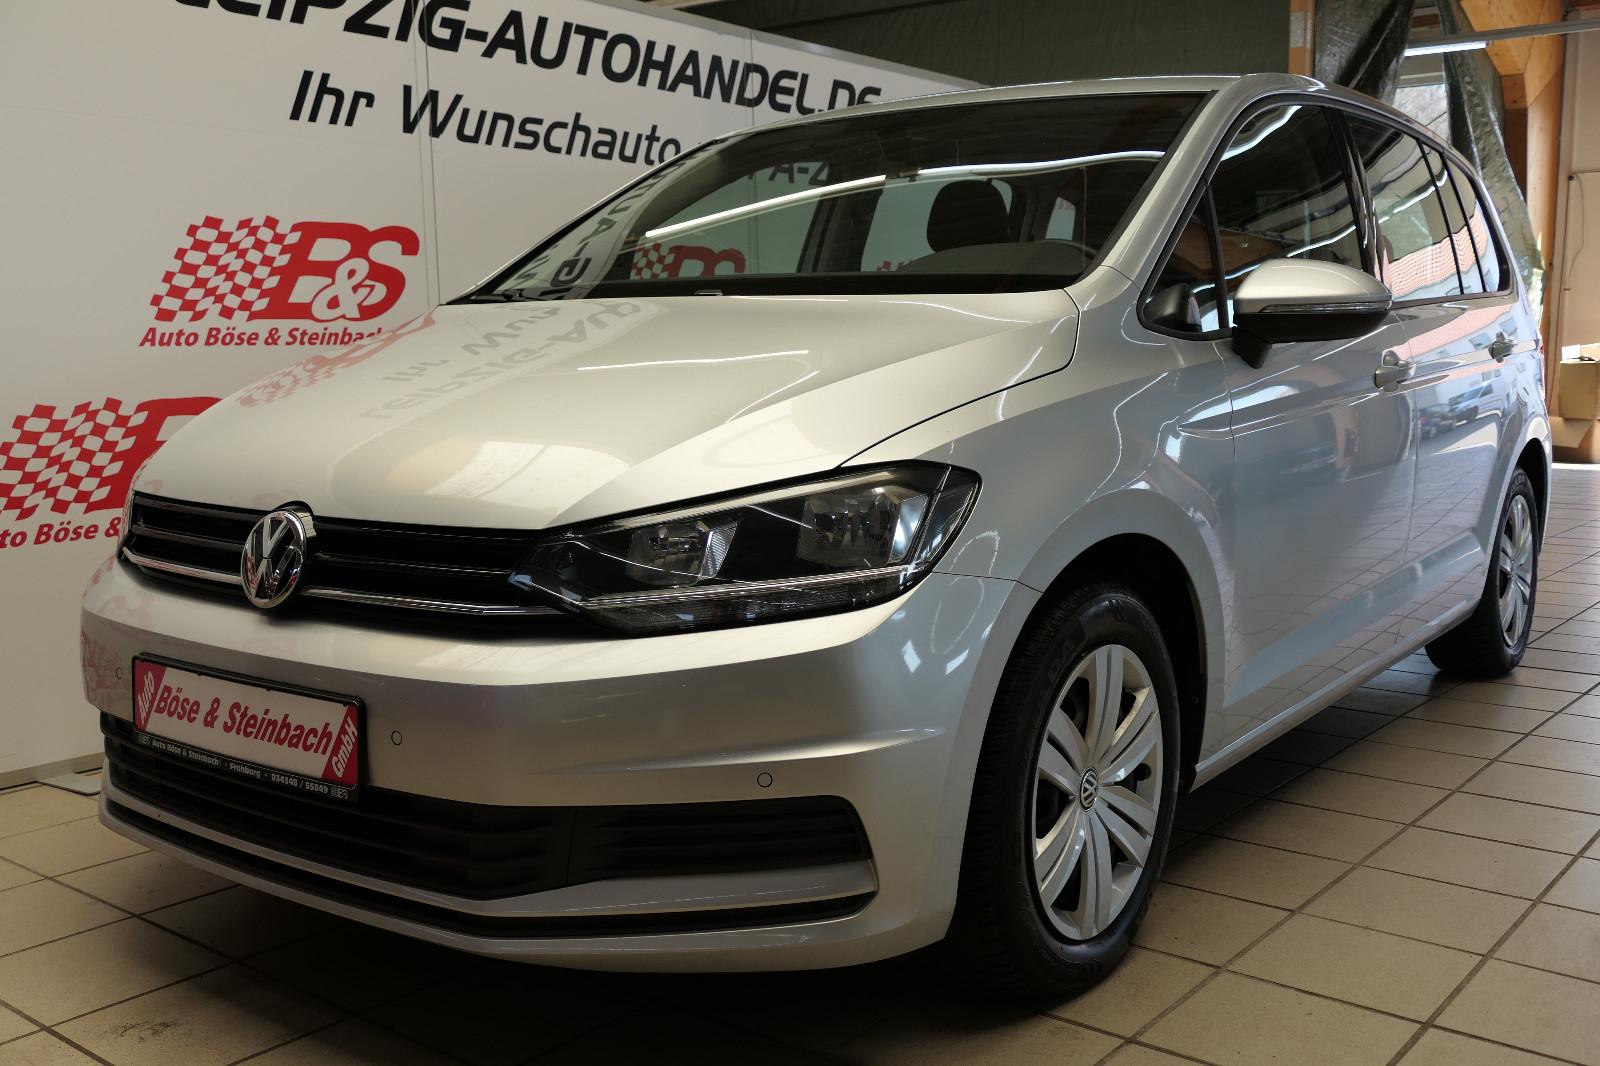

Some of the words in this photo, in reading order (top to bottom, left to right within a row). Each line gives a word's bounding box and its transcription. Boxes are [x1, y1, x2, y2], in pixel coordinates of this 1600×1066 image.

[289, 70, 376, 127] Ihr
[402, 85, 681, 166] Wunschauto
[139, 327, 199, 347] Auto
[204, 326, 259, 347] Böse
[264, 328, 281, 346] &
[34, 520, 99, 545] Böse
[104, 516, 121, 537] &
[138, 671, 155, 724] Auto
[154, 685, 200, 724] Böse
[204, 697, 221, 728] &
[223, 701, 334, 756] Steinbach
[152, 739, 166, 750] Auto
[331, 717, 359, 778] GmbH
